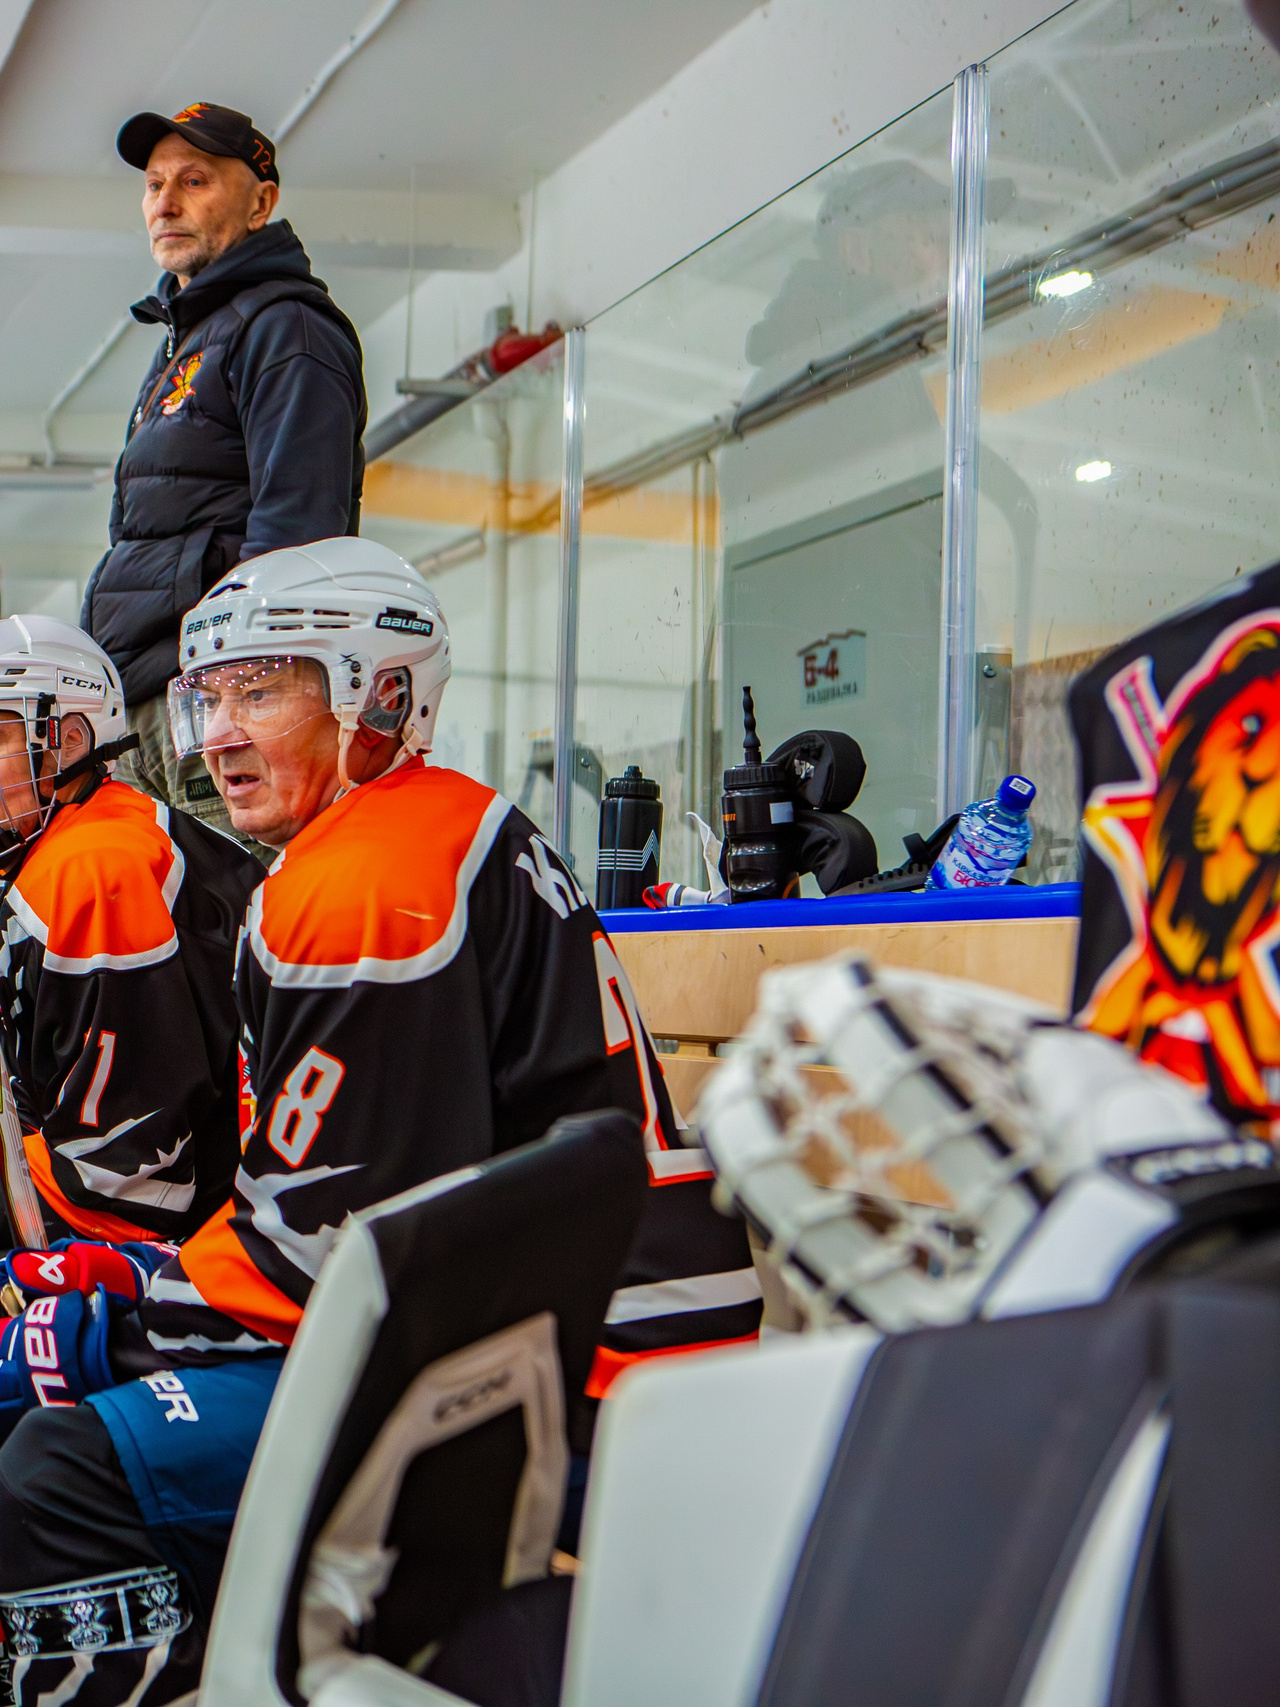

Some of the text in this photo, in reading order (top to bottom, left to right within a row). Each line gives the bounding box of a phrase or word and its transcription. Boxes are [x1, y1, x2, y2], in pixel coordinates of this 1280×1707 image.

[252, 139, 271, 174] 72
[186, 612, 232, 635] BAUER
[378, 616, 431, 632] BAUER
[61, 676, 103, 692] CCM
